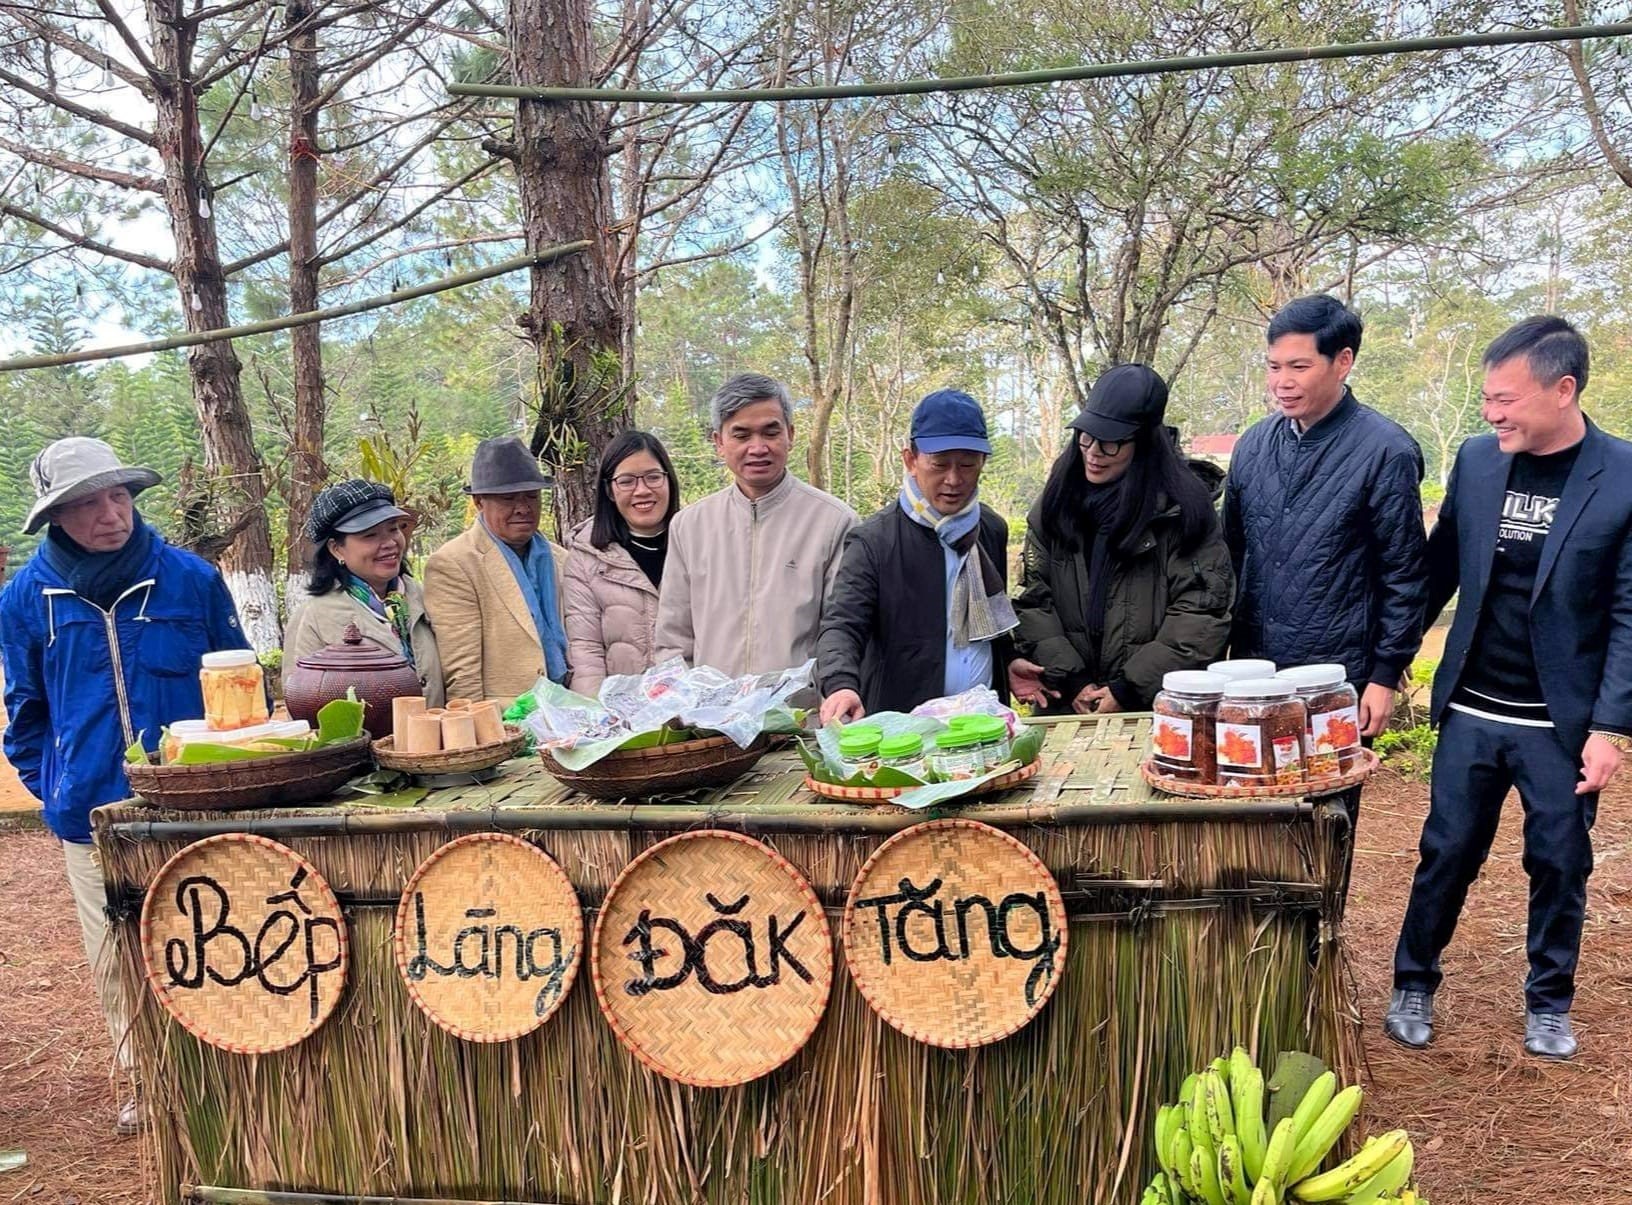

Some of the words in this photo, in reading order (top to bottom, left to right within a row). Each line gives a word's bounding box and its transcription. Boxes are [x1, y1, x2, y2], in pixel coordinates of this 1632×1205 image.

[1502, 492, 1559, 526] ILK
[1499, 529, 1533, 542] OLUTION
[165, 867, 343, 1024] Bếp
[855, 877, 1062, 1009] Tăng
